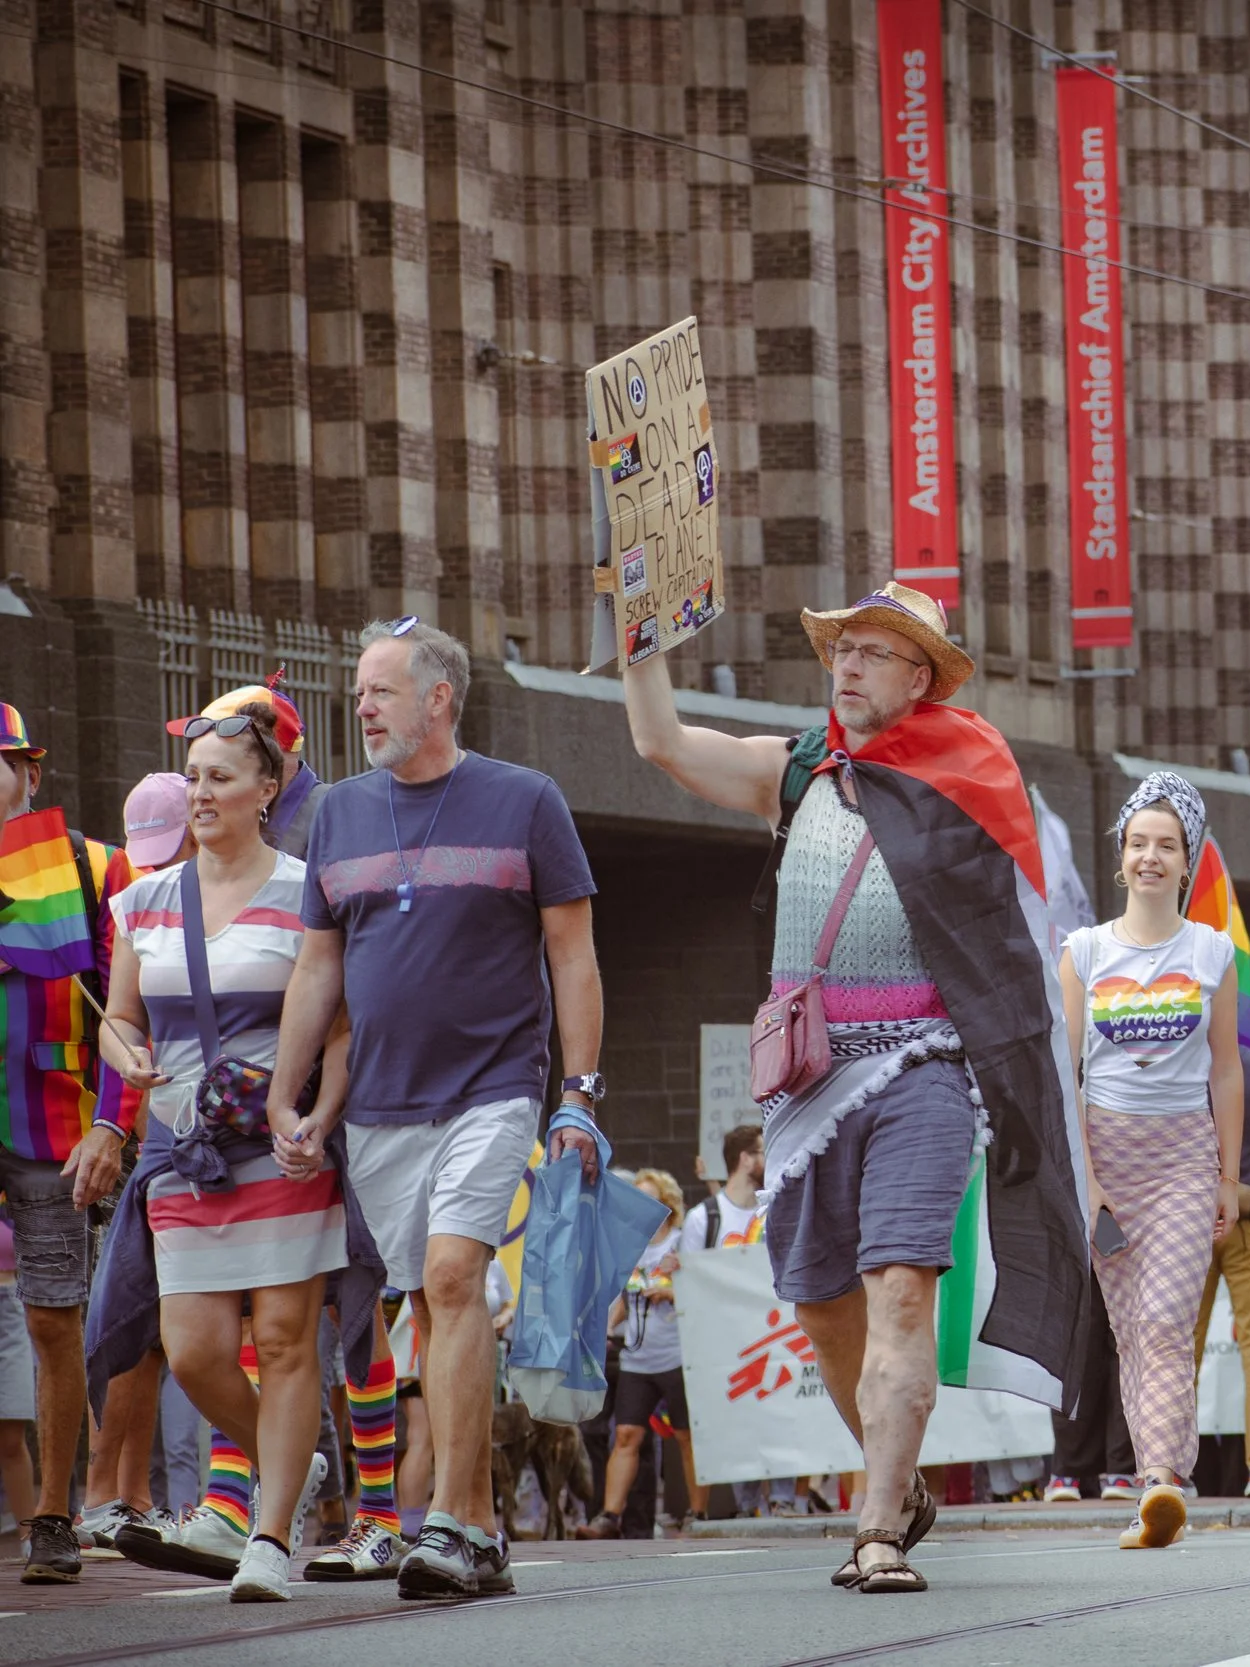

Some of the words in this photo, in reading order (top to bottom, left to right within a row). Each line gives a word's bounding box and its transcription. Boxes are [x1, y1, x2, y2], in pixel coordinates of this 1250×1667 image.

[896, 49, 927, 202] Archives
[902, 208, 941, 292] City
[1074, 127, 1110, 334] Amsterdam
[601, 356, 647, 435] NO
[650, 323, 703, 405] PRIDE
[903, 303, 941, 516] Amsterdam
[645, 408, 680, 472] ON
[687, 402, 700, 450] A
[1079, 340, 1117, 560] Stadsarchief
[616, 460, 693, 552] DEAD
[655, 502, 713, 585] PLANET
[625, 585, 663, 625] SCREW
[1109, 988, 1186, 1012] LOVE
[1109, 1010, 1191, 1027] WITHOUT
[1112, 1025, 1190, 1043] BORDERS
